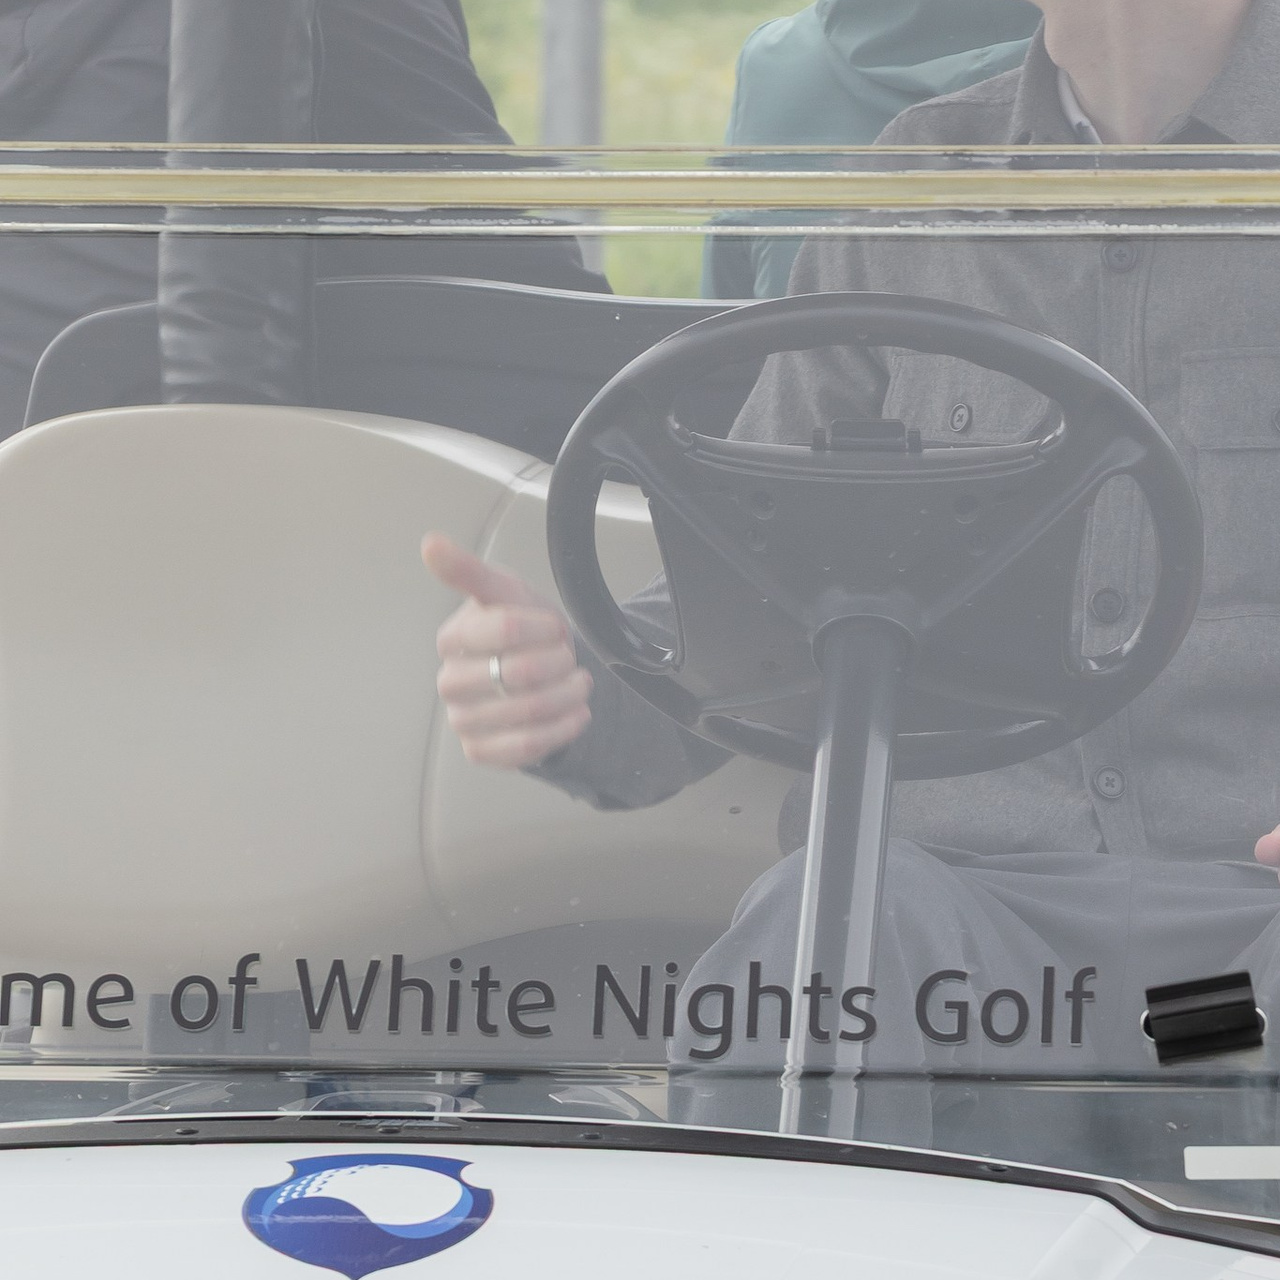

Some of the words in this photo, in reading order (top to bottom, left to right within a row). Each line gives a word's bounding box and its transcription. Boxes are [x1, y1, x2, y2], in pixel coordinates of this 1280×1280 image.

[170, 953, 260, 1030] of
[296, 954, 555, 1039] White
[592, 961, 877, 1060] Nights
[915, 966, 1098, 1044] Golf
